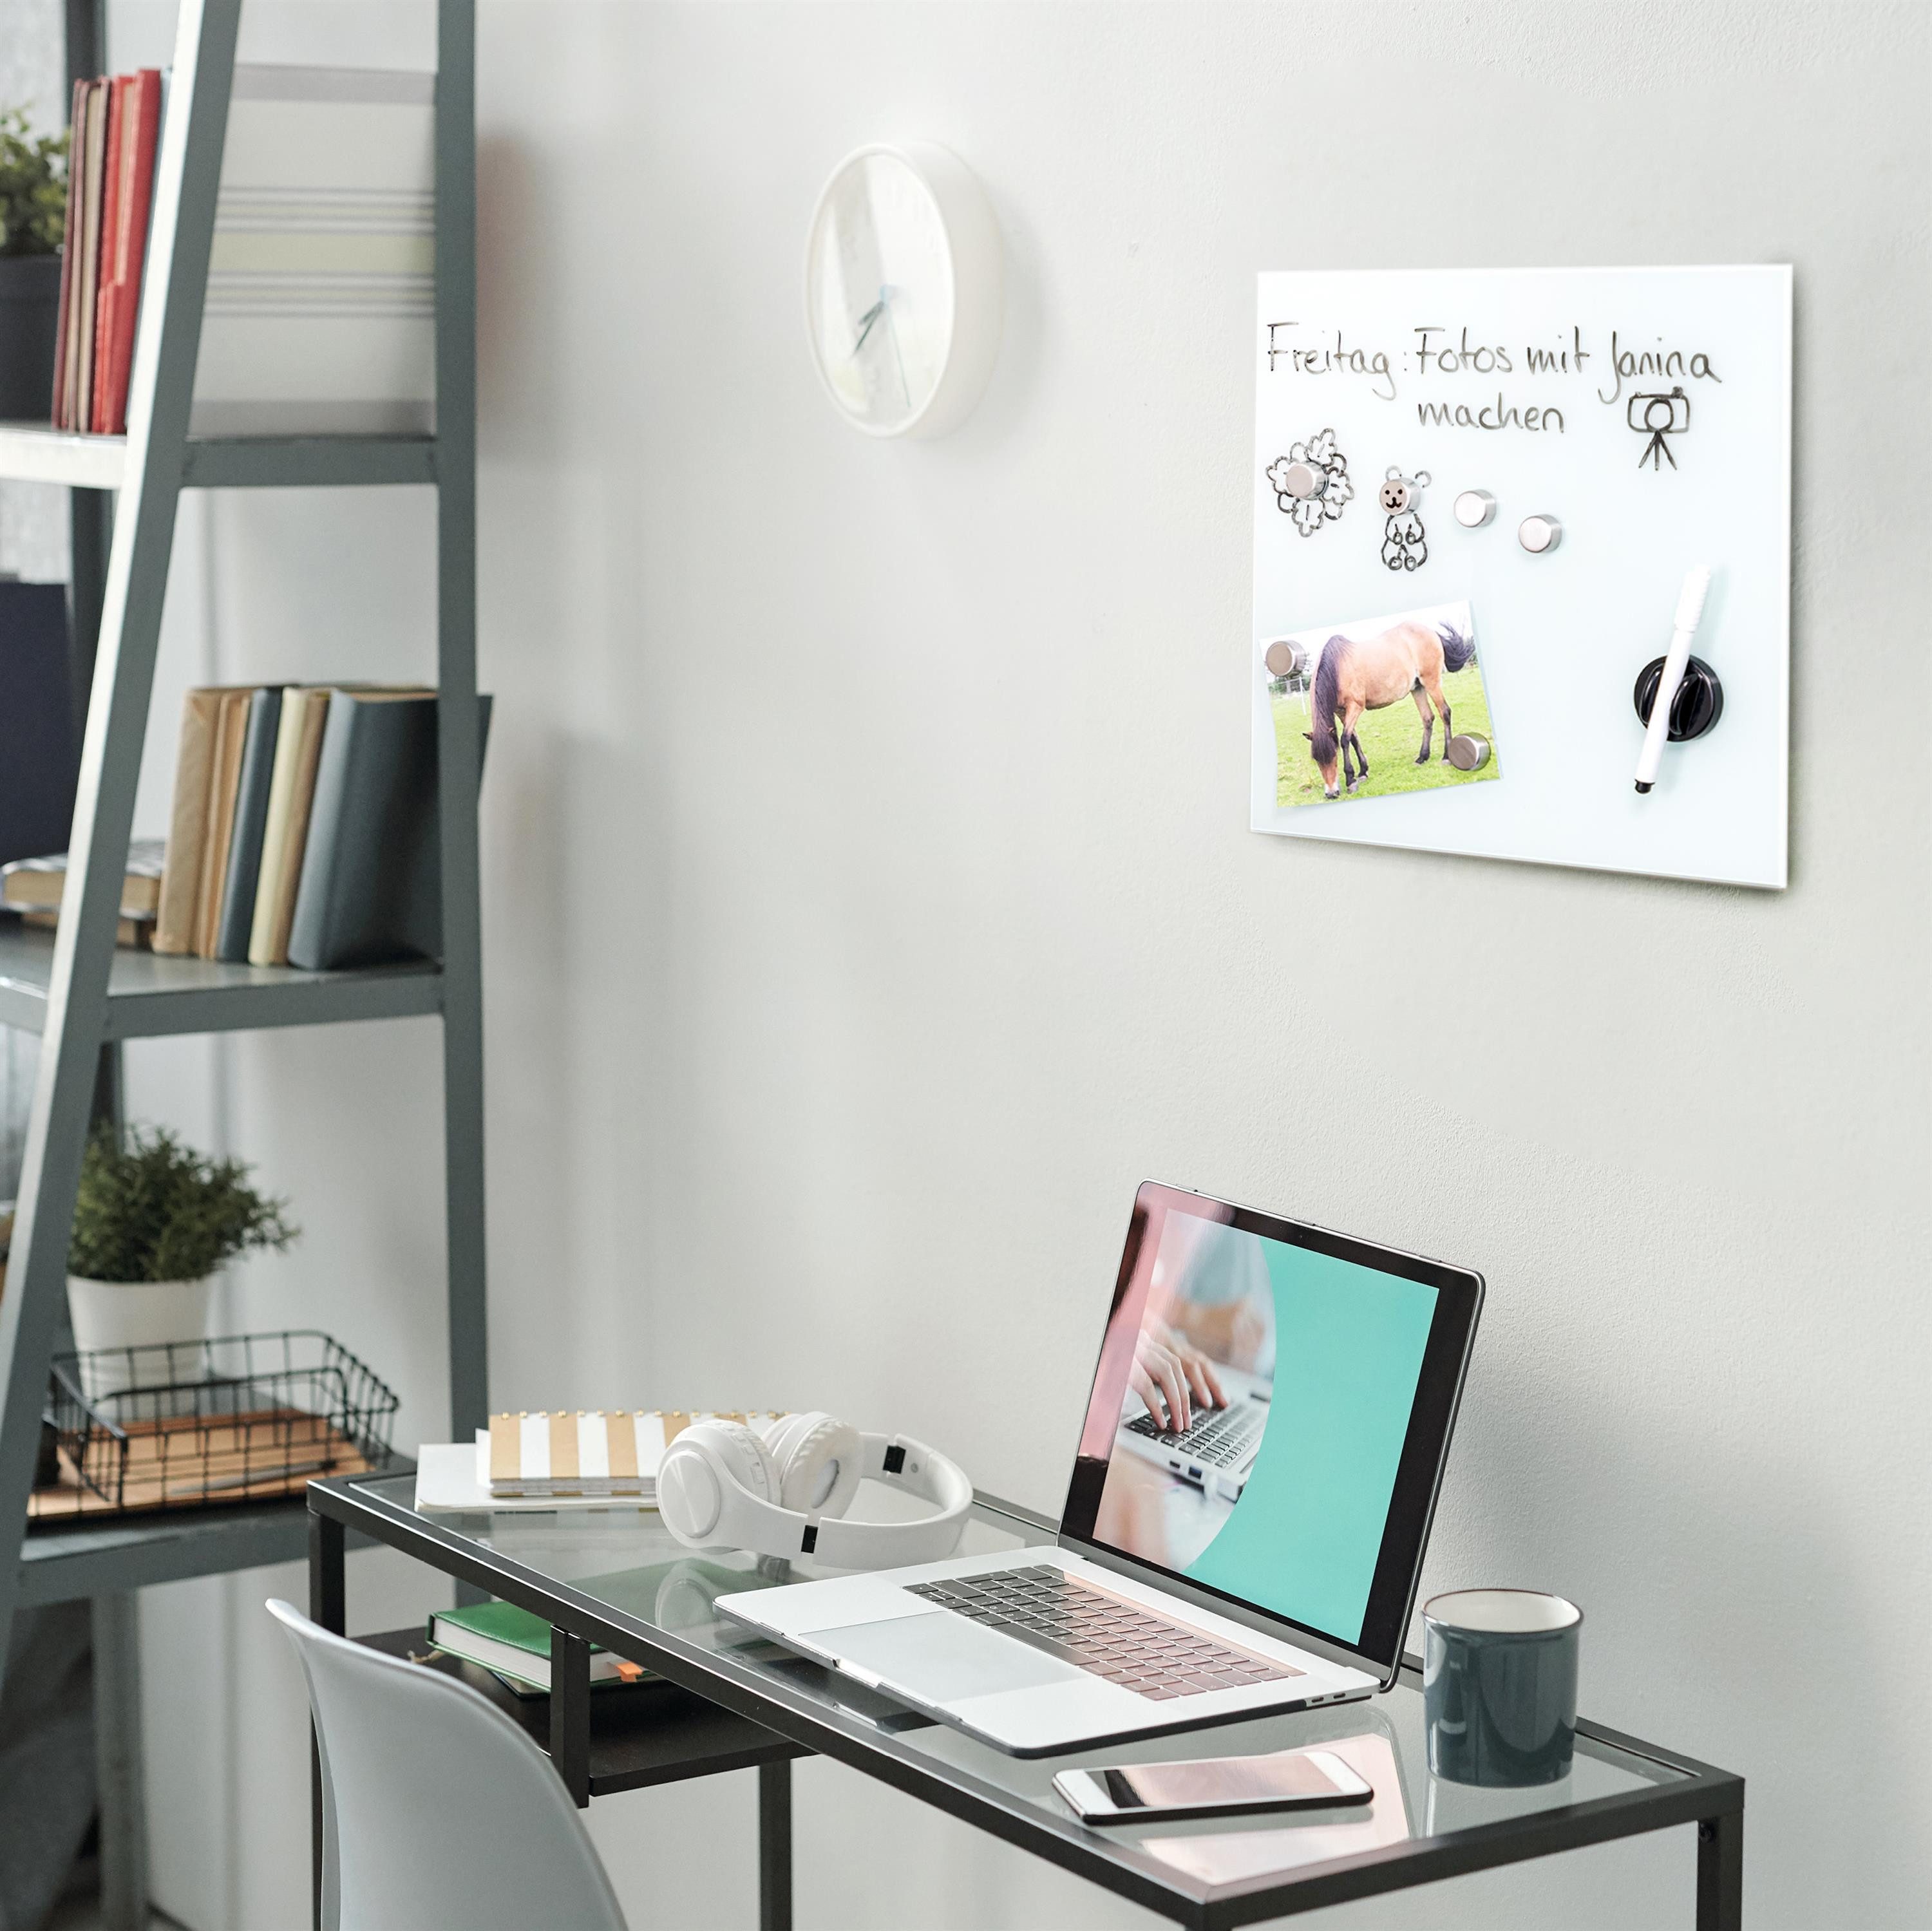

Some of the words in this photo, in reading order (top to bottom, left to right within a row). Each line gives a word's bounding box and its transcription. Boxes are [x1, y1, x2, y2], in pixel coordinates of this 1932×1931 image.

[1414, 326, 1513, 375] Fotos
[1526, 325, 1591, 375] mit
[1598, 330, 1723, 405] Janina
[1417, 391, 1564, 434] machen
